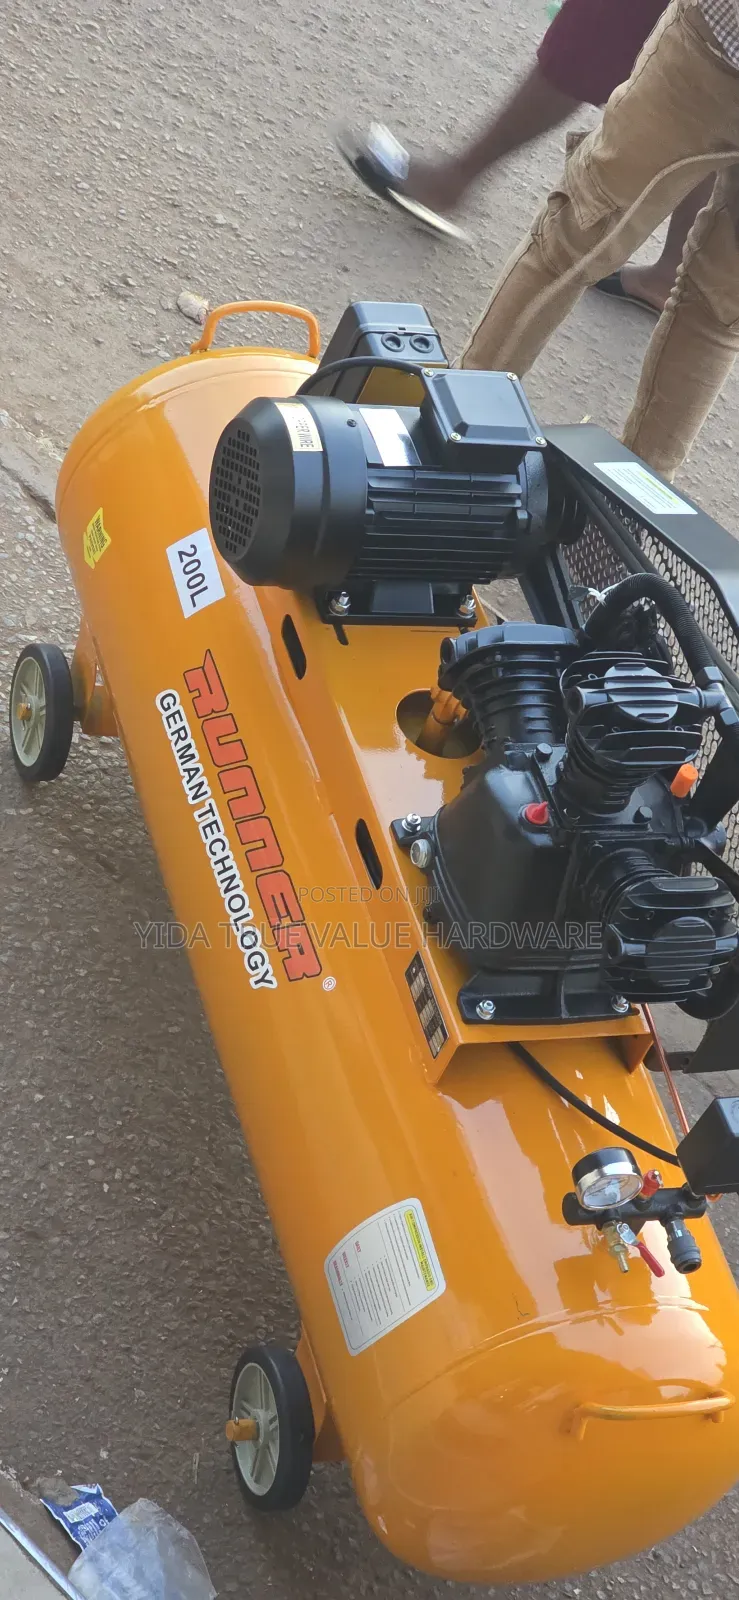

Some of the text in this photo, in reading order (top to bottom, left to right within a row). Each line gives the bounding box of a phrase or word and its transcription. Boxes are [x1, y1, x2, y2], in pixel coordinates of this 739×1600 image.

[177, 544, 209, 608] 200L
[159, 692, 274, 987] GERMAN TECHNOLOGY
[183, 649, 322, 981] RUNNER
